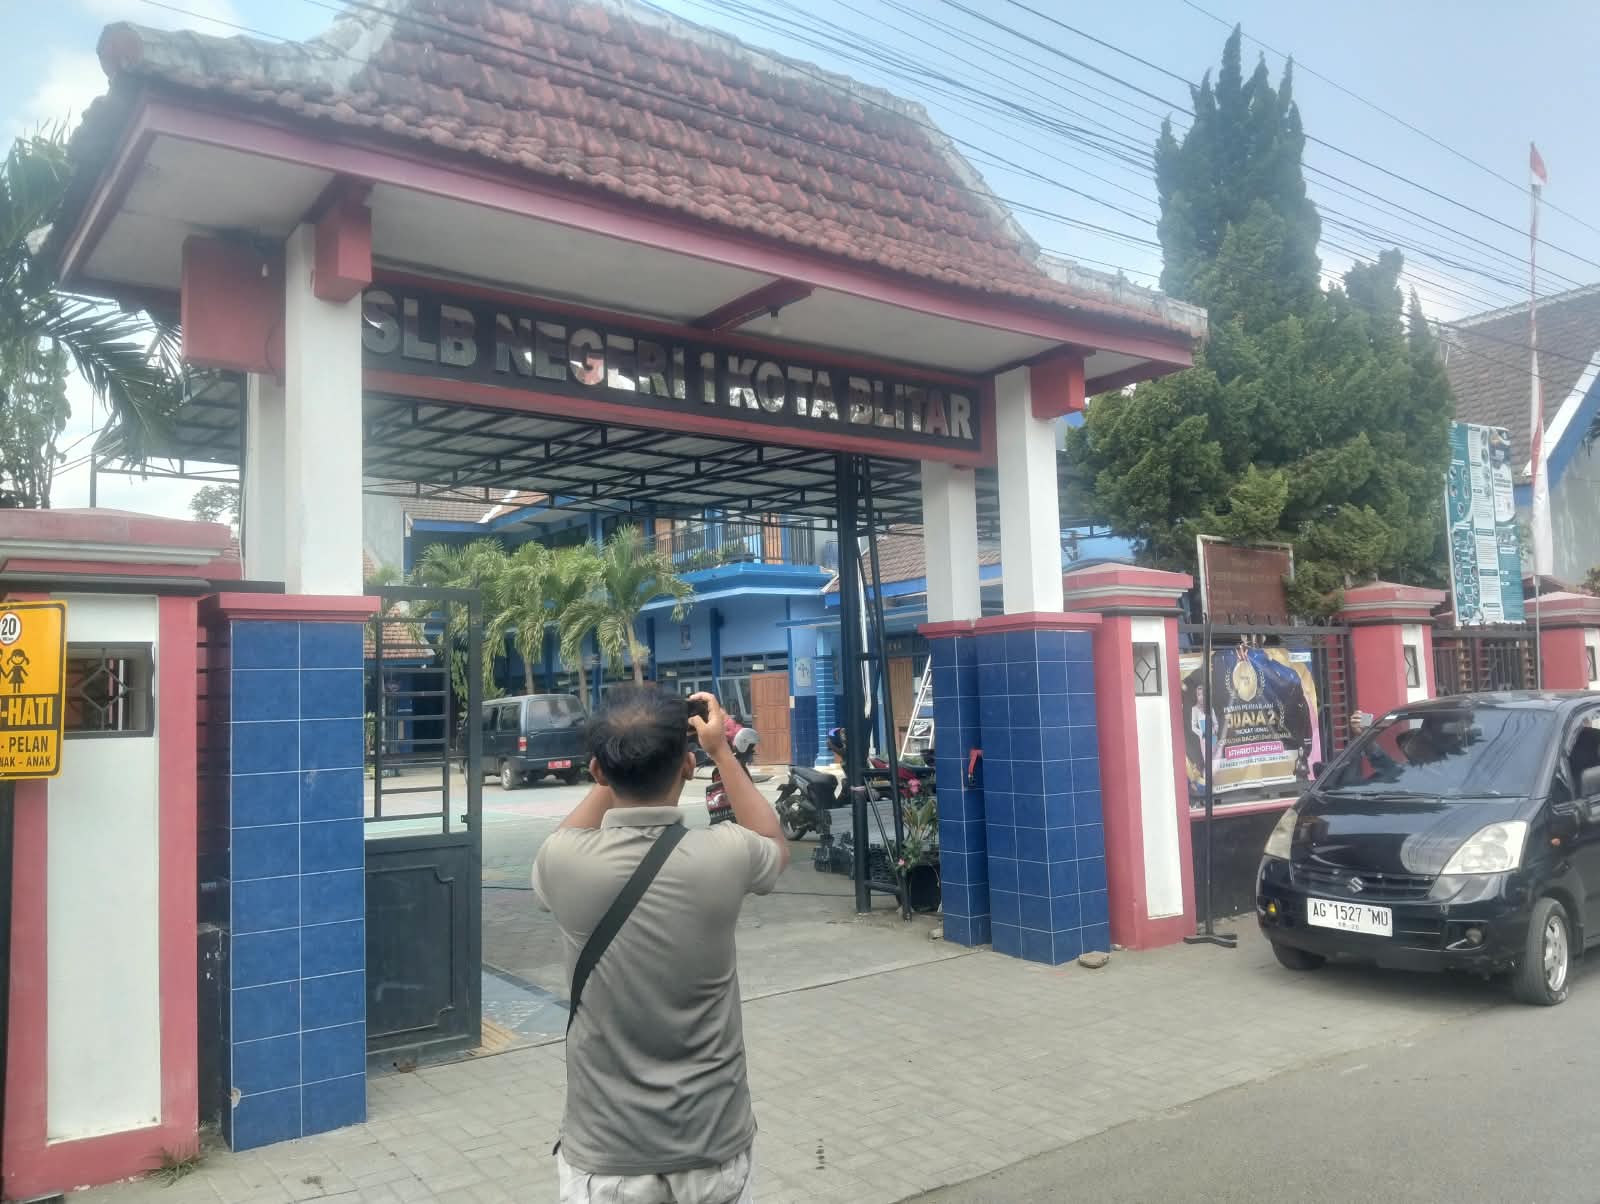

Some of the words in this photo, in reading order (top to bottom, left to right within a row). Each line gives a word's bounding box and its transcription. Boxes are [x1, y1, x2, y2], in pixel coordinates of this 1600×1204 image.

[362, 290, 477, 368] SLB
[496, 312, 687, 400] NEGERI
[700, 351, 716, 404] 1
[728, 355, 840, 421] KOTA
[849, 375, 974, 441] BLITAR
[1, 617, 17, 636] 20
[0, 696, 54, 726] -HATI
[9, 735, 49, 753] PELAN
[26, 755, 51, 768] ANAK
[1312, 901, 1327, 918] AG
[1334, 904, 1362, 923] 1527
[1371, 910, 1389, 927] MU
